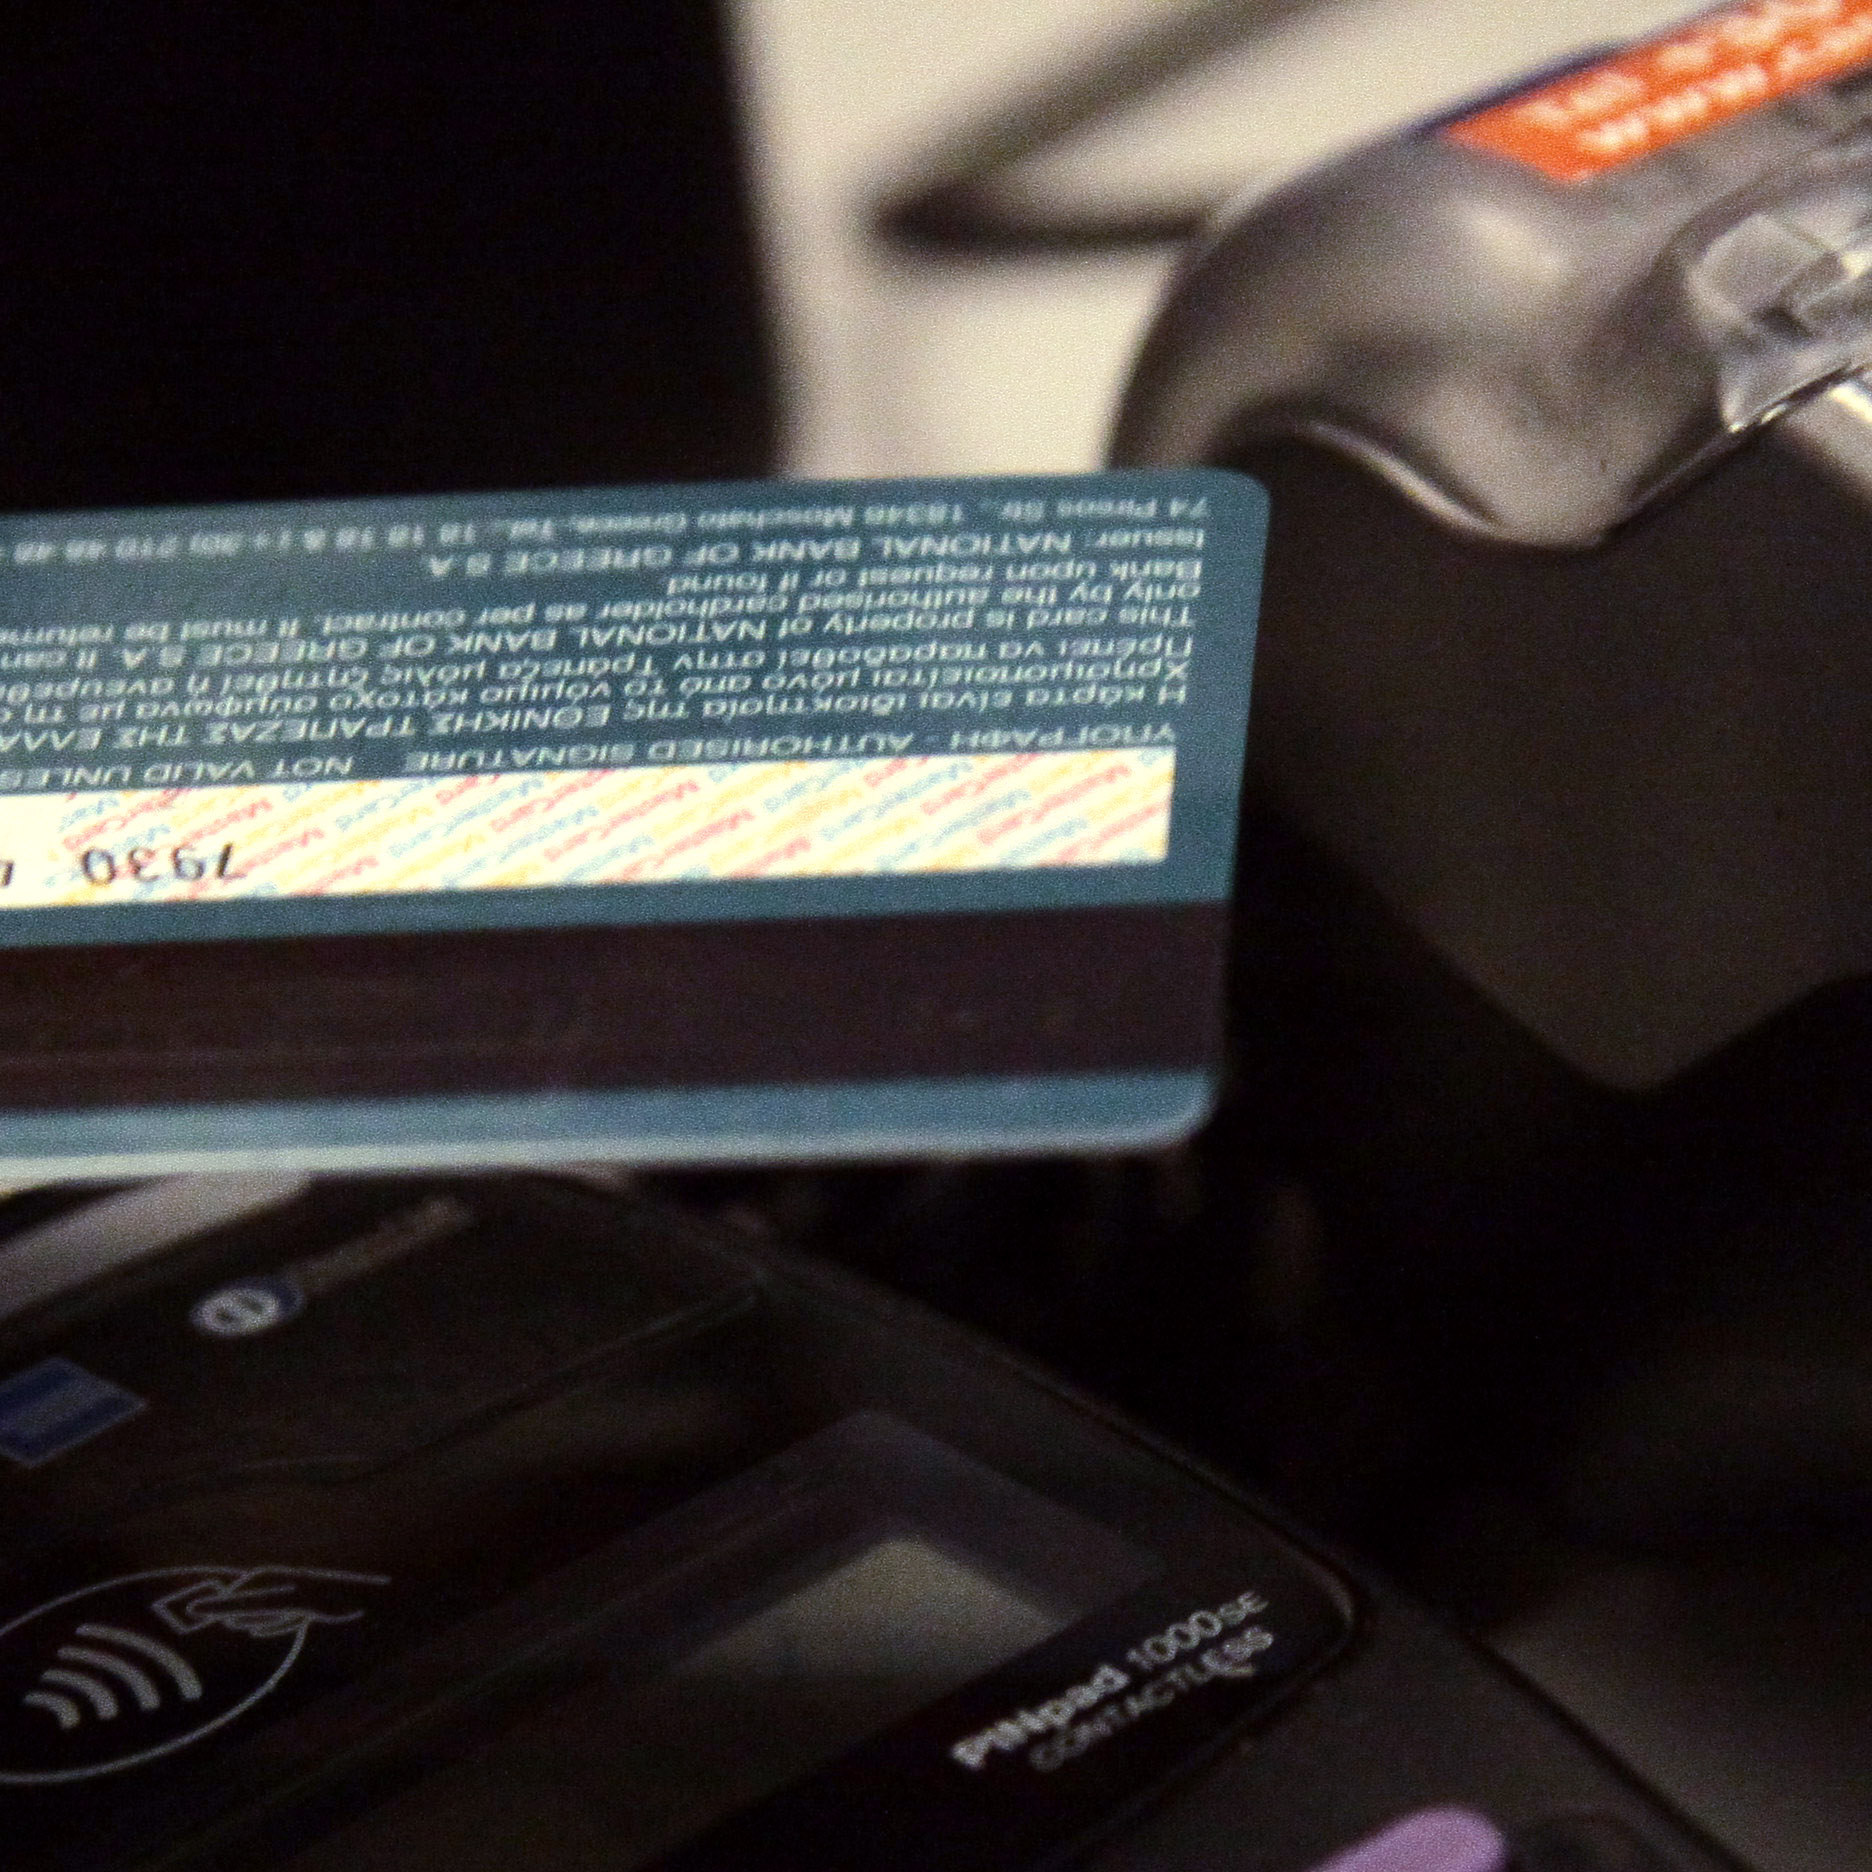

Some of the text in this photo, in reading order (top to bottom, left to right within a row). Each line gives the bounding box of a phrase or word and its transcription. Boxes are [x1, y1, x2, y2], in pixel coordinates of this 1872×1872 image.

[684, 541, 740, 568] OF
[748, 537, 861, 565] BANK
[868, 530, 1072, 560] NATIONAL
[597, 593, 787, 621] cardholder
[1025, 607, 1107, 631] card
[1116, 602, 1193, 628] This
[568, 619, 766, 648] NATIONAL
[777, 618, 813, 639] of
[822, 608, 973, 637] property
[197, 635, 371, 664] GREECE
[379, 634, 437, 658] OF
[446, 628, 557, 653] BANK
[404, 742, 635, 772] SIGNATURE
[647, 731, 914, 760] AUTHORISED
[140, 759, 257, 783] VALID
[272, 755, 356, 779] NOT
[78, 843, 242, 888] 7930
